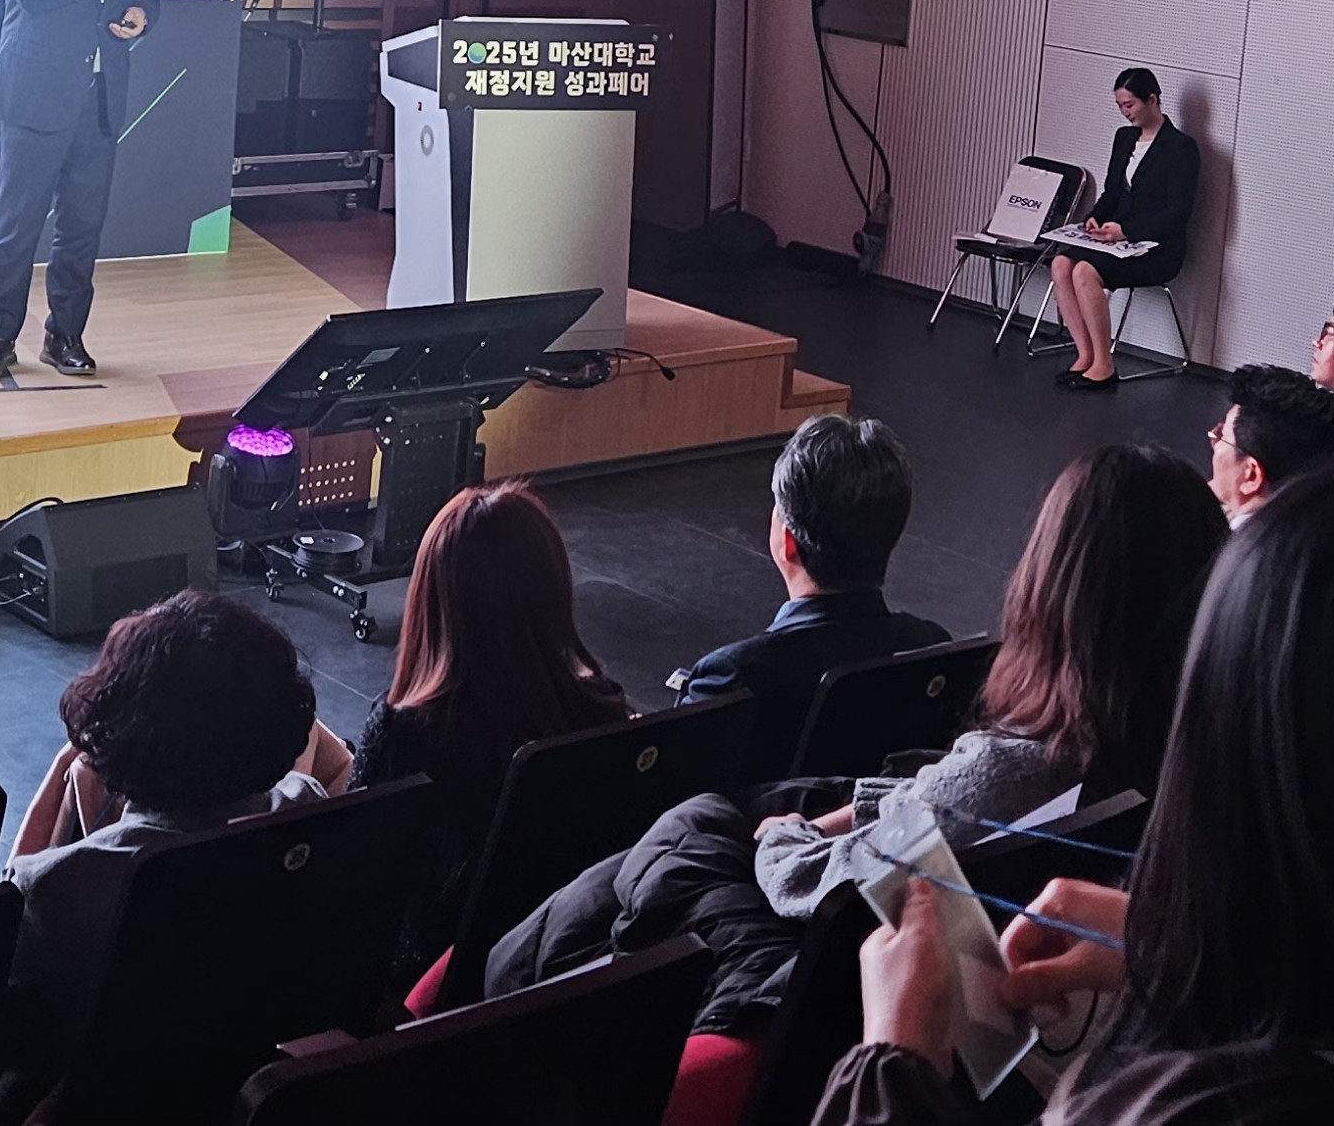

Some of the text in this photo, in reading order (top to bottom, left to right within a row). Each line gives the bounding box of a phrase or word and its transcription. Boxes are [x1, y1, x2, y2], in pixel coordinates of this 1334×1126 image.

[452, 39, 656, 68] 2025년 마산대학교
[465, 70, 649, 97] 재정지원 성과페어
[1008, 195, 1042, 210] EPSON
